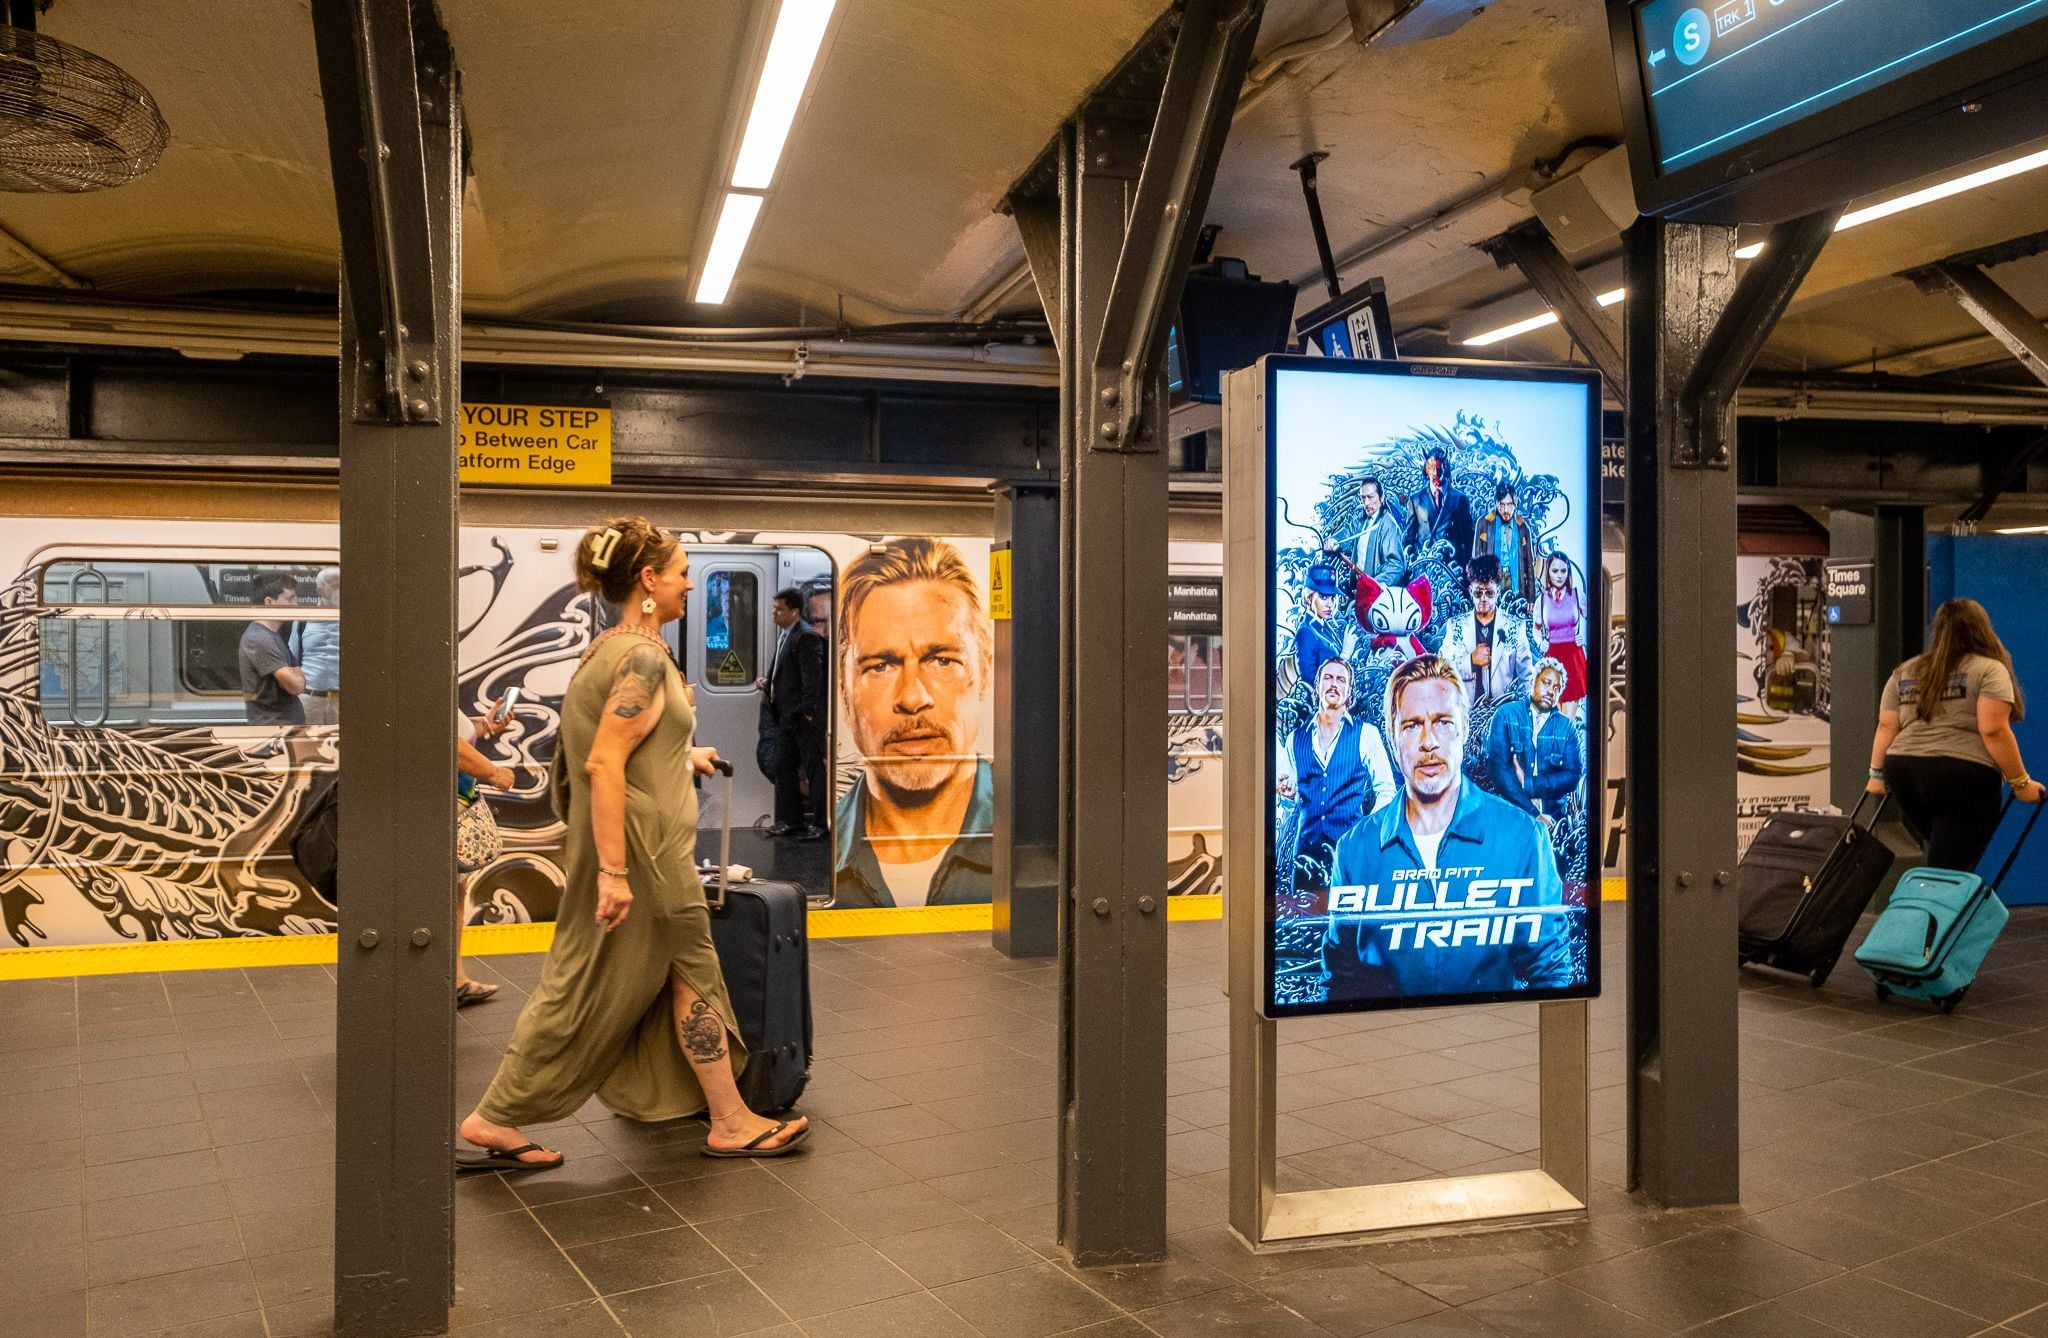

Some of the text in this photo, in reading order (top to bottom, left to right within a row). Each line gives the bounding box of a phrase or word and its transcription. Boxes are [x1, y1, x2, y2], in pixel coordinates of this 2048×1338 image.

[1683, 22, 1701, 51] S
[1717, 8, 1741, 31] TRK
[463, 406, 599, 429] YOUR STEP
[475, 431, 558, 449] Between
[566, 434, 599, 450] Car
[1602, 443, 1625, 459] ate
[459, 453, 576, 474] atform Edge
[1602, 461, 1625, 478] ake
[223, 573, 250, 582] Grand
[1828, 569, 1860, 583] Times
[224, 594, 250, 603] Times
[1173, 586, 1218, 597] Manhattan
[1828, 582, 1866, 599] Square
[1173, 611, 1217, 621] Manhattan
[1763, 795, 1810, 803] THEATERS
[1738, 804, 1788, 817] UST
[1392, 866, 1485, 881] BRAD PITT
[1328, 878, 1534, 911] BULLET
[1380, 913, 1543, 951] TRAIN
